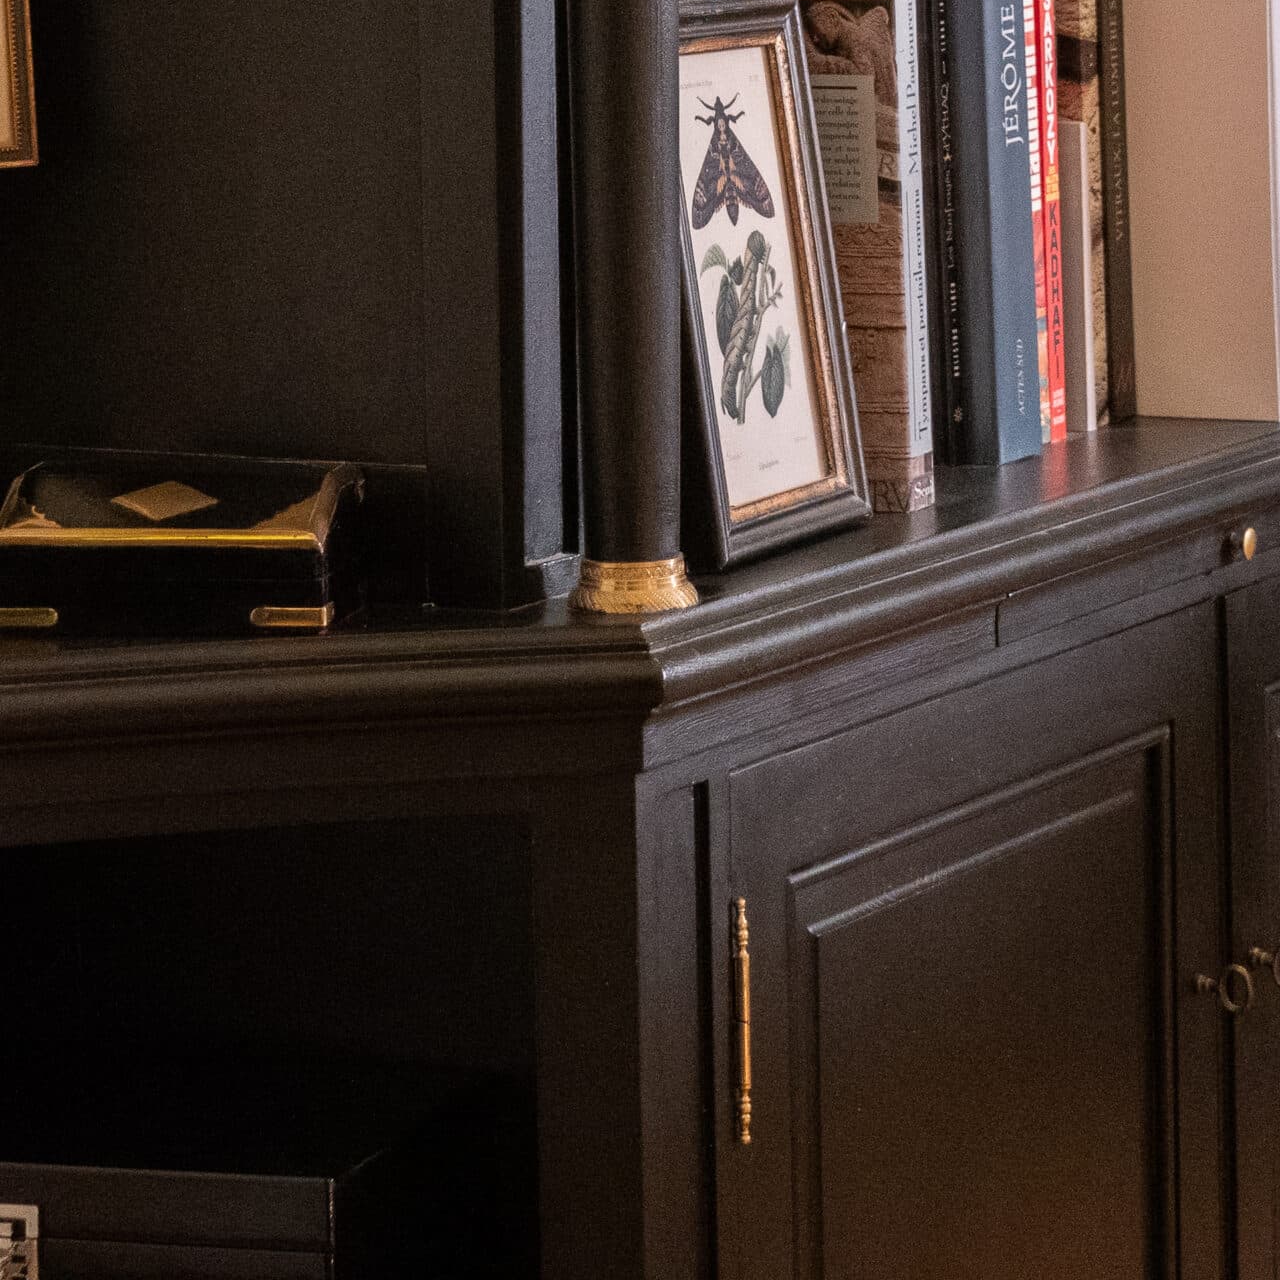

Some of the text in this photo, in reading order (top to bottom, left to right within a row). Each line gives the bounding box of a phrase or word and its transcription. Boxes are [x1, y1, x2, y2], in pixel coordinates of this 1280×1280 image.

[1001, 4, 1024, 148] JÉRÔME
[907, 105, 921, 176] Michel
[913, 187, 922, 257] romans
[913, 261, 926, 330] portails
[918, 356, 929, 441] Tympans
